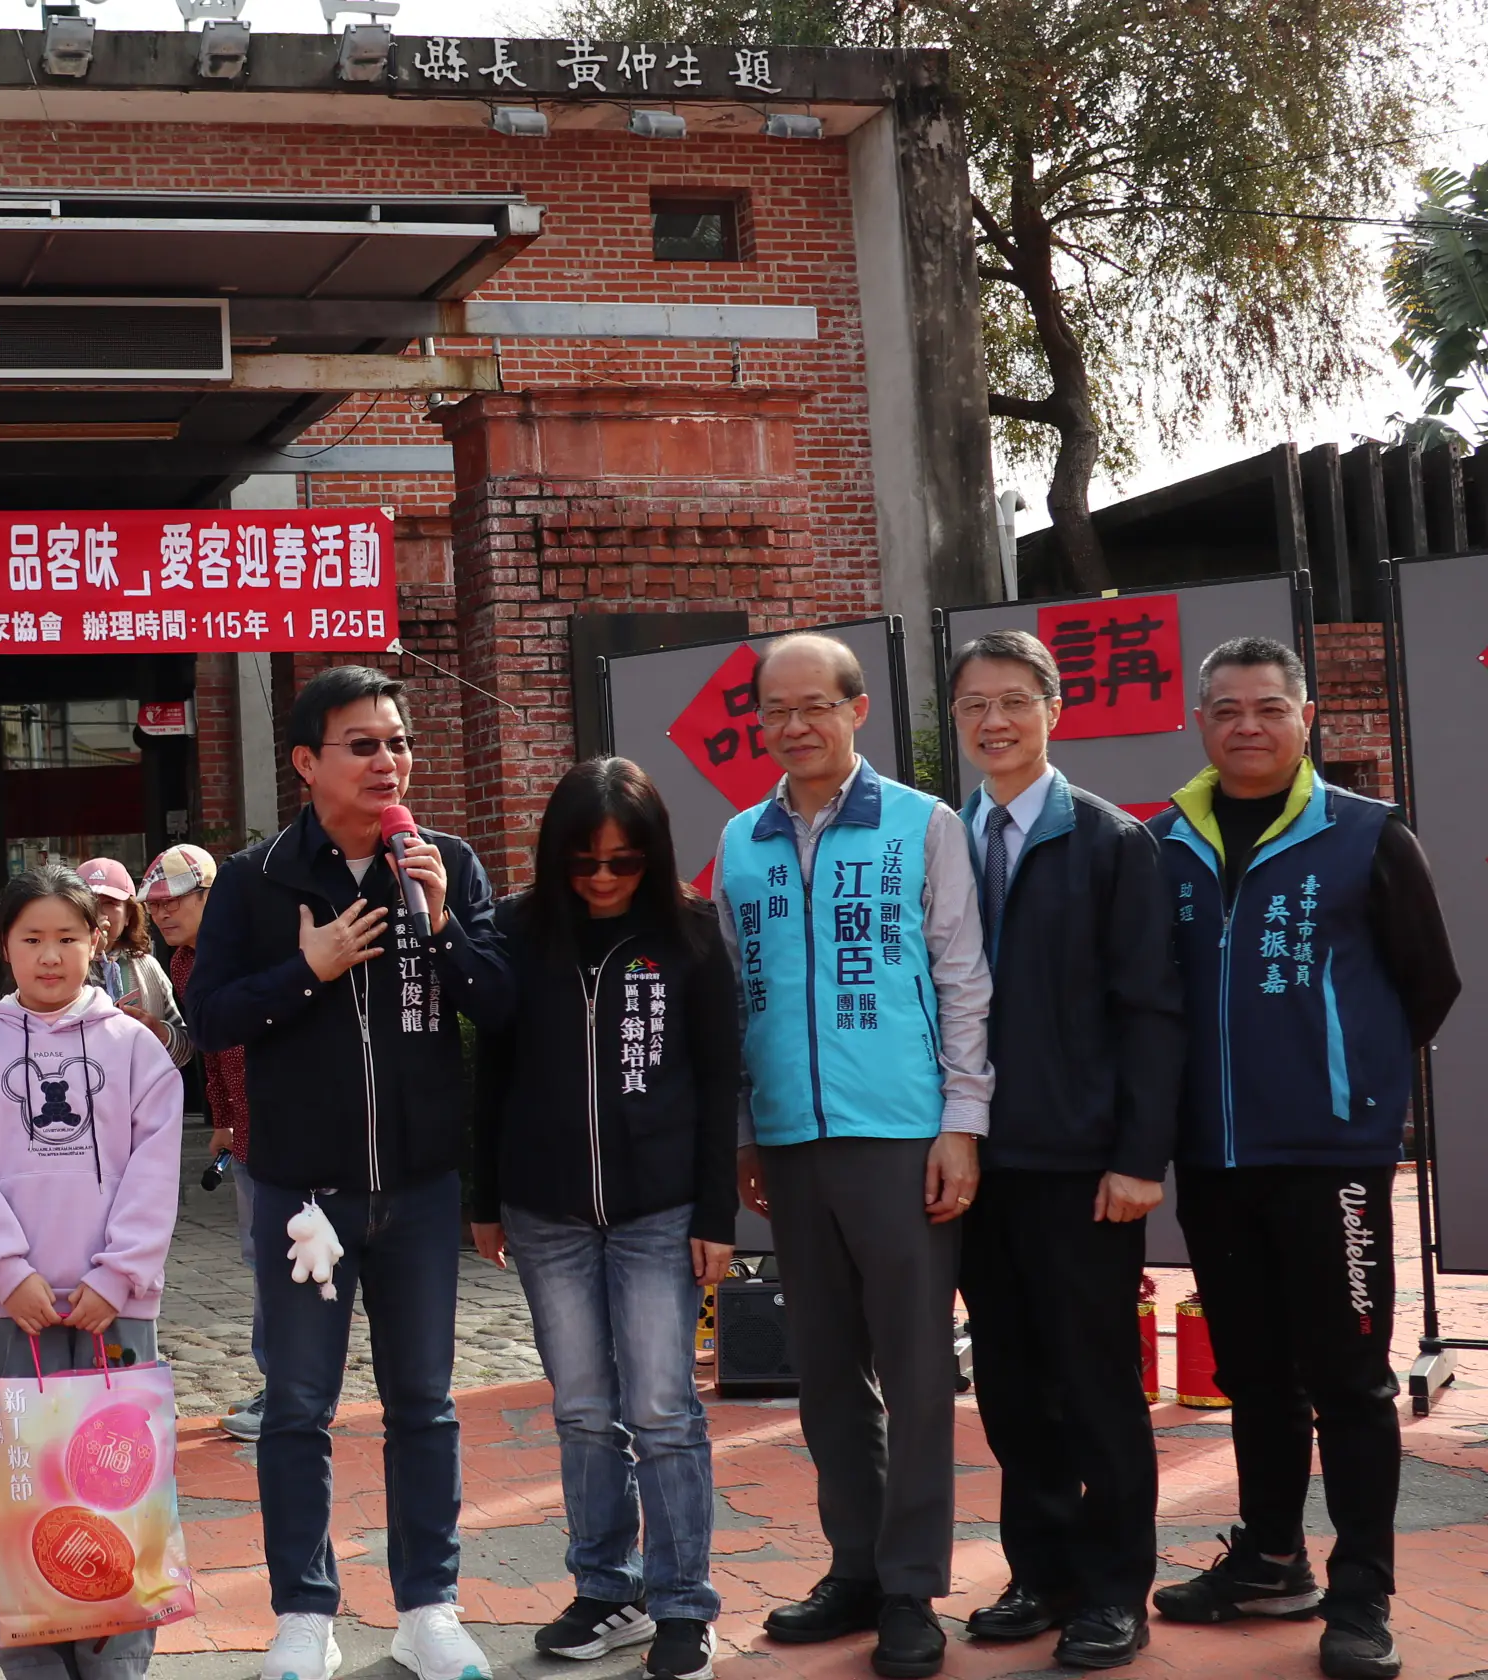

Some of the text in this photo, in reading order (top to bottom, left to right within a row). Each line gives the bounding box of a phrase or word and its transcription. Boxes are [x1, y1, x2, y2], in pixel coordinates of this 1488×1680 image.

[414, 37, 782, 95] 縣長 黃仲生 題
[1051, 613, 1172, 711] 講
[767, 863, 790, 920] 特助
[880, 838, 904, 966] 立法院 副院長
[1178, 881, 1195, 923] 助理
[1292, 873, 1321, 988] 臺中市議員
[1259, 894, 1291, 994] 吳振嘉
[398, 955, 424, 1033] 江俊龍
[620, 983, 647, 1095] 區長 翁培真
[648, 982, 667, 1067] 東勢區公所
